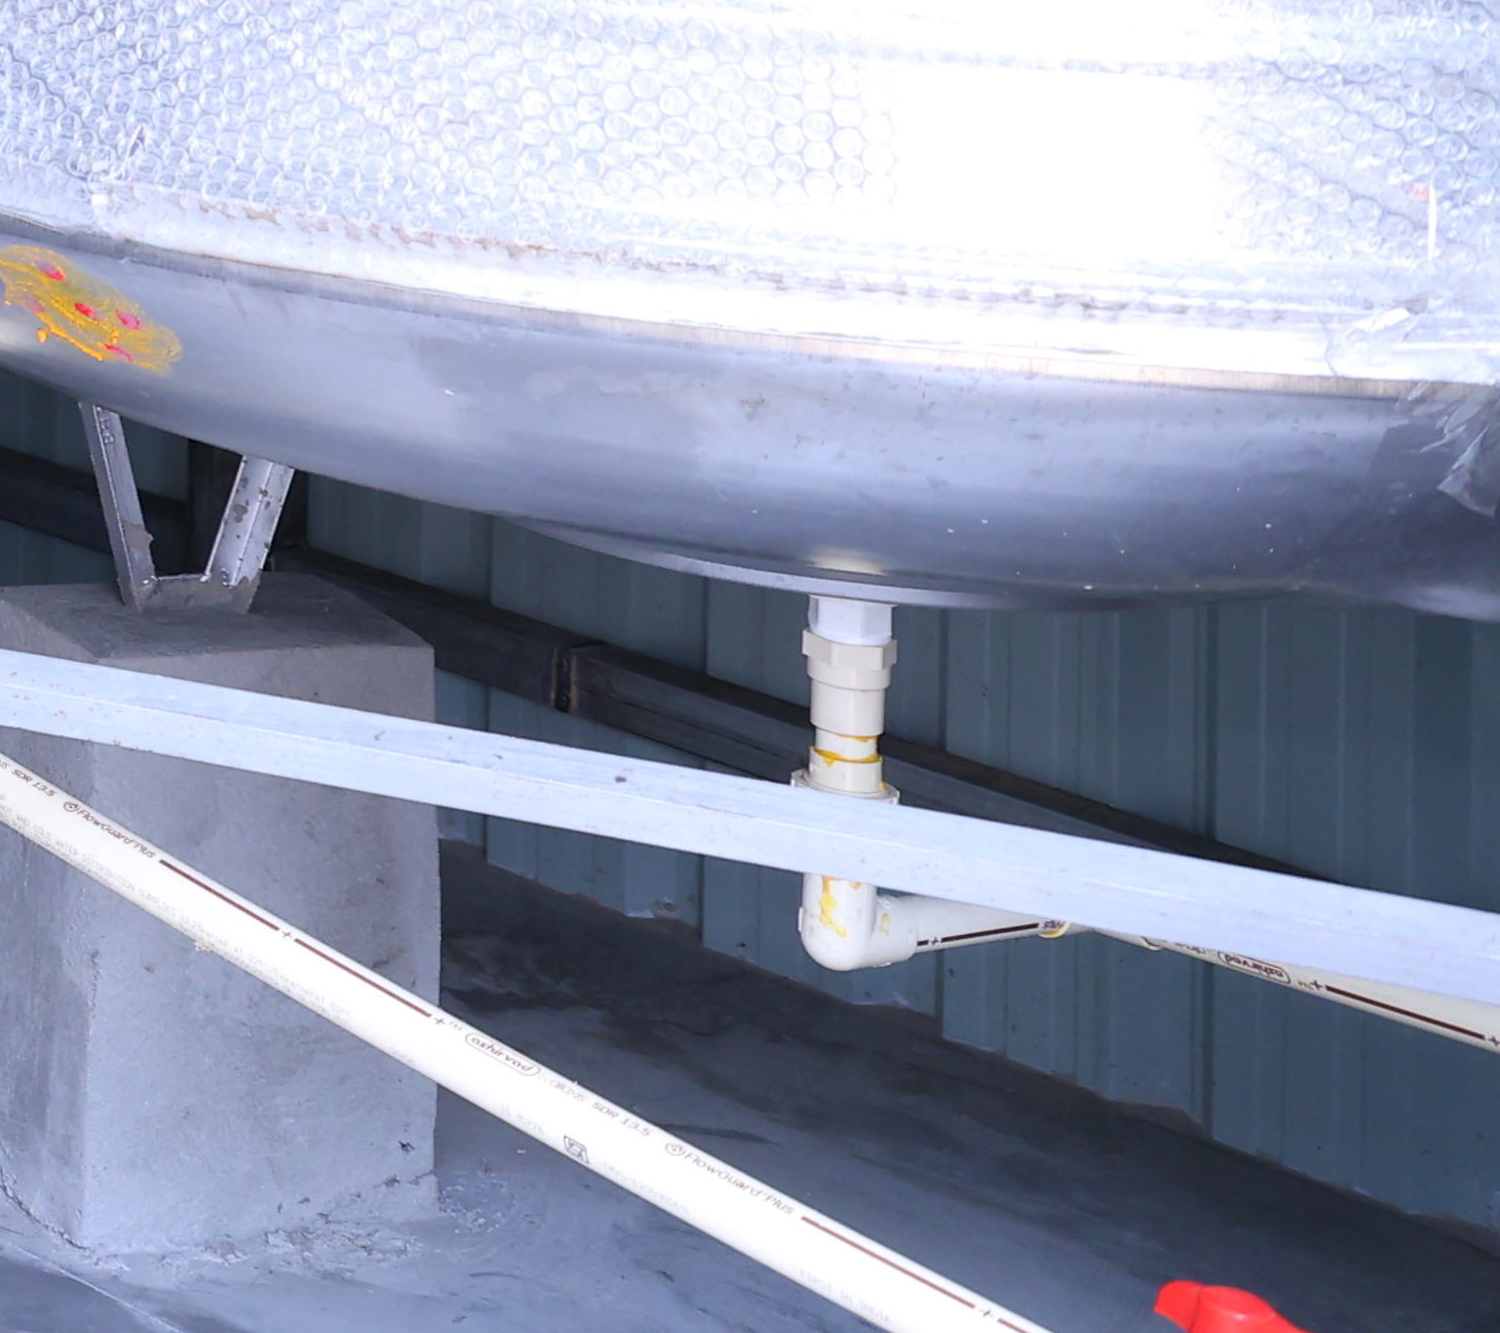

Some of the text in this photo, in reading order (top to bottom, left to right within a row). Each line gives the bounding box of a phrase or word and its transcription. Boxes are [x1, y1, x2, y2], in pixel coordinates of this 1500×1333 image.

[10, 765, 34, 785] SDR
[30, 778, 56, 798] 13.5
[75, 805, 134, 846] FlowGuard
[130, 839, 156, 860] Plus
[14, 812, 32, 828] AND
[31, 823, 53, 841] COLD
[53, 837, 79, 856] WATER
[79, 852, 137, 892] DISTRIBUTION
[136, 887, 178, 917] SUPPLIES
[1225, 953, 1284, 980] ashirvad
[468, 1032, 535, 1075] ashirvad
[590, 1099, 620, 1121] SDR
[618, 1114, 653, 1139] 13.5
[683, 1148, 763, 1199] FlowGuard
[762, 1191, 797, 1217] Plus
